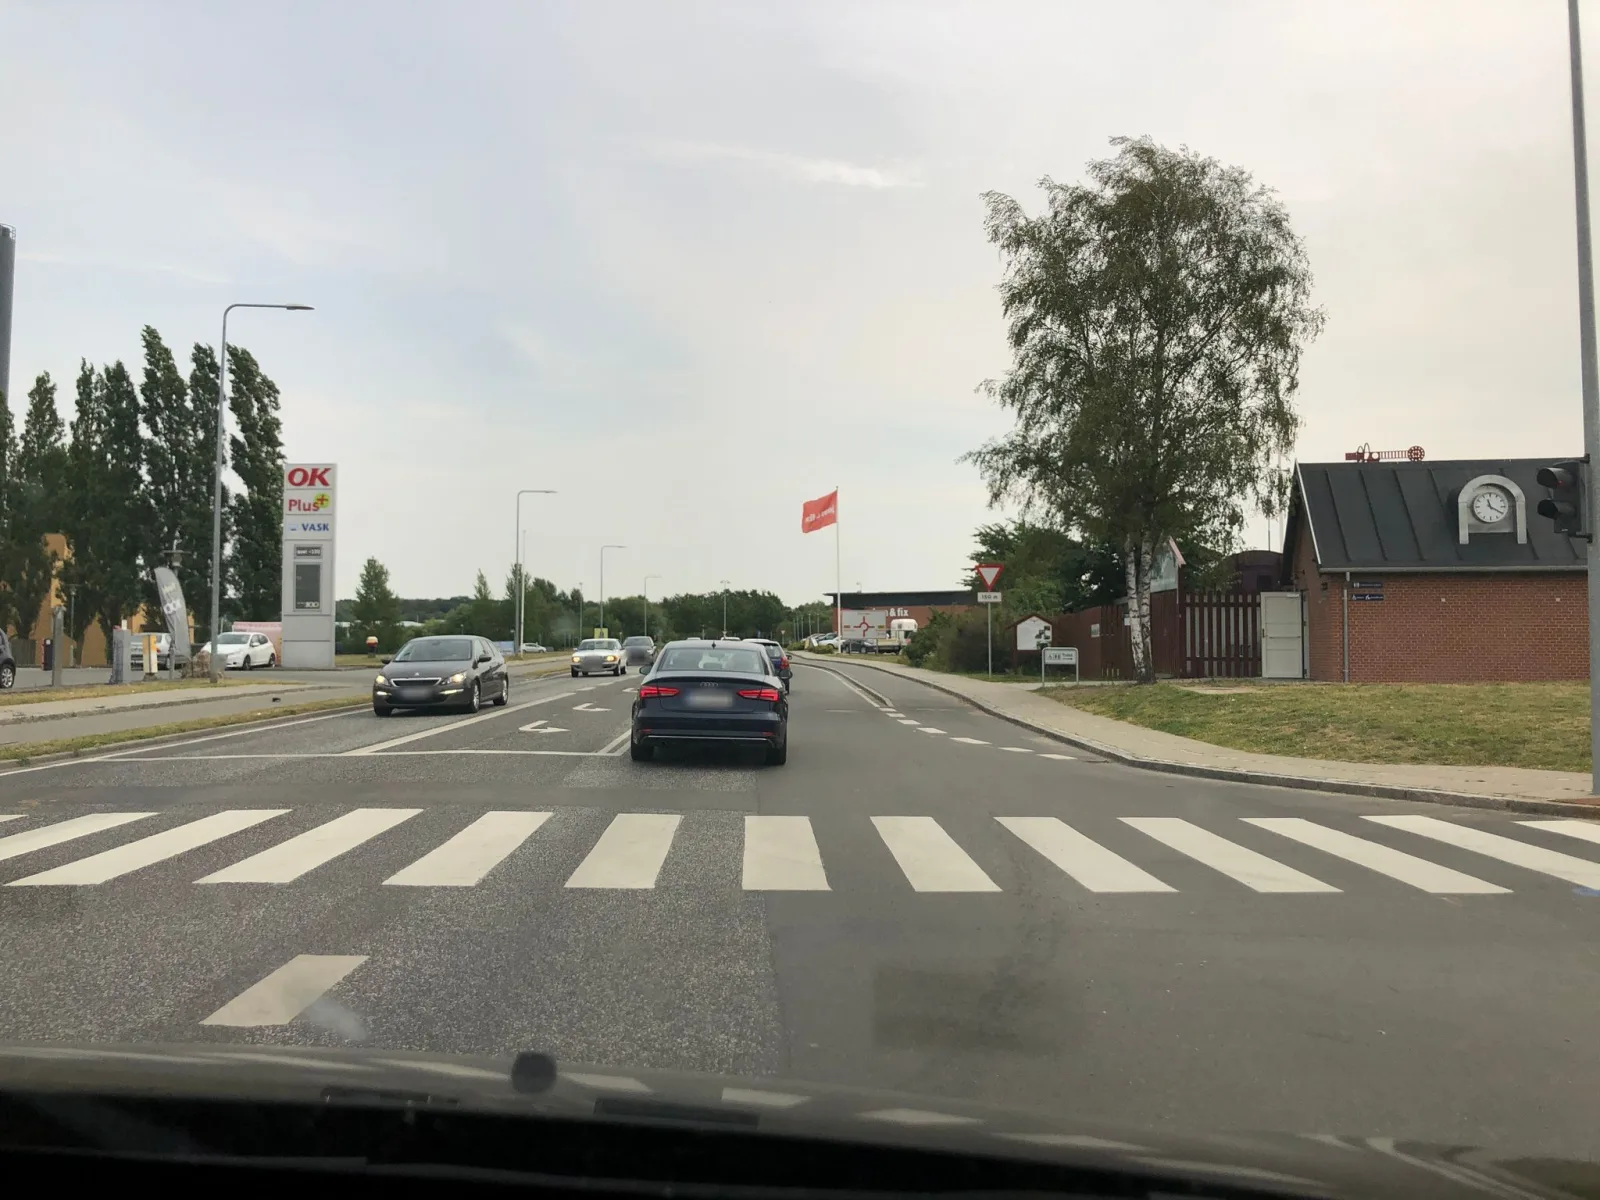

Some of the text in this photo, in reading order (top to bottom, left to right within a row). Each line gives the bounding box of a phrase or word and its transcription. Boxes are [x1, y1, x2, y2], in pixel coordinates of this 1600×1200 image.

[287, 467, 332, 487] OK
[301, 523, 330, 532] VASK
[889, 607, 896, 617] &
[897, 607, 909, 617] fix
